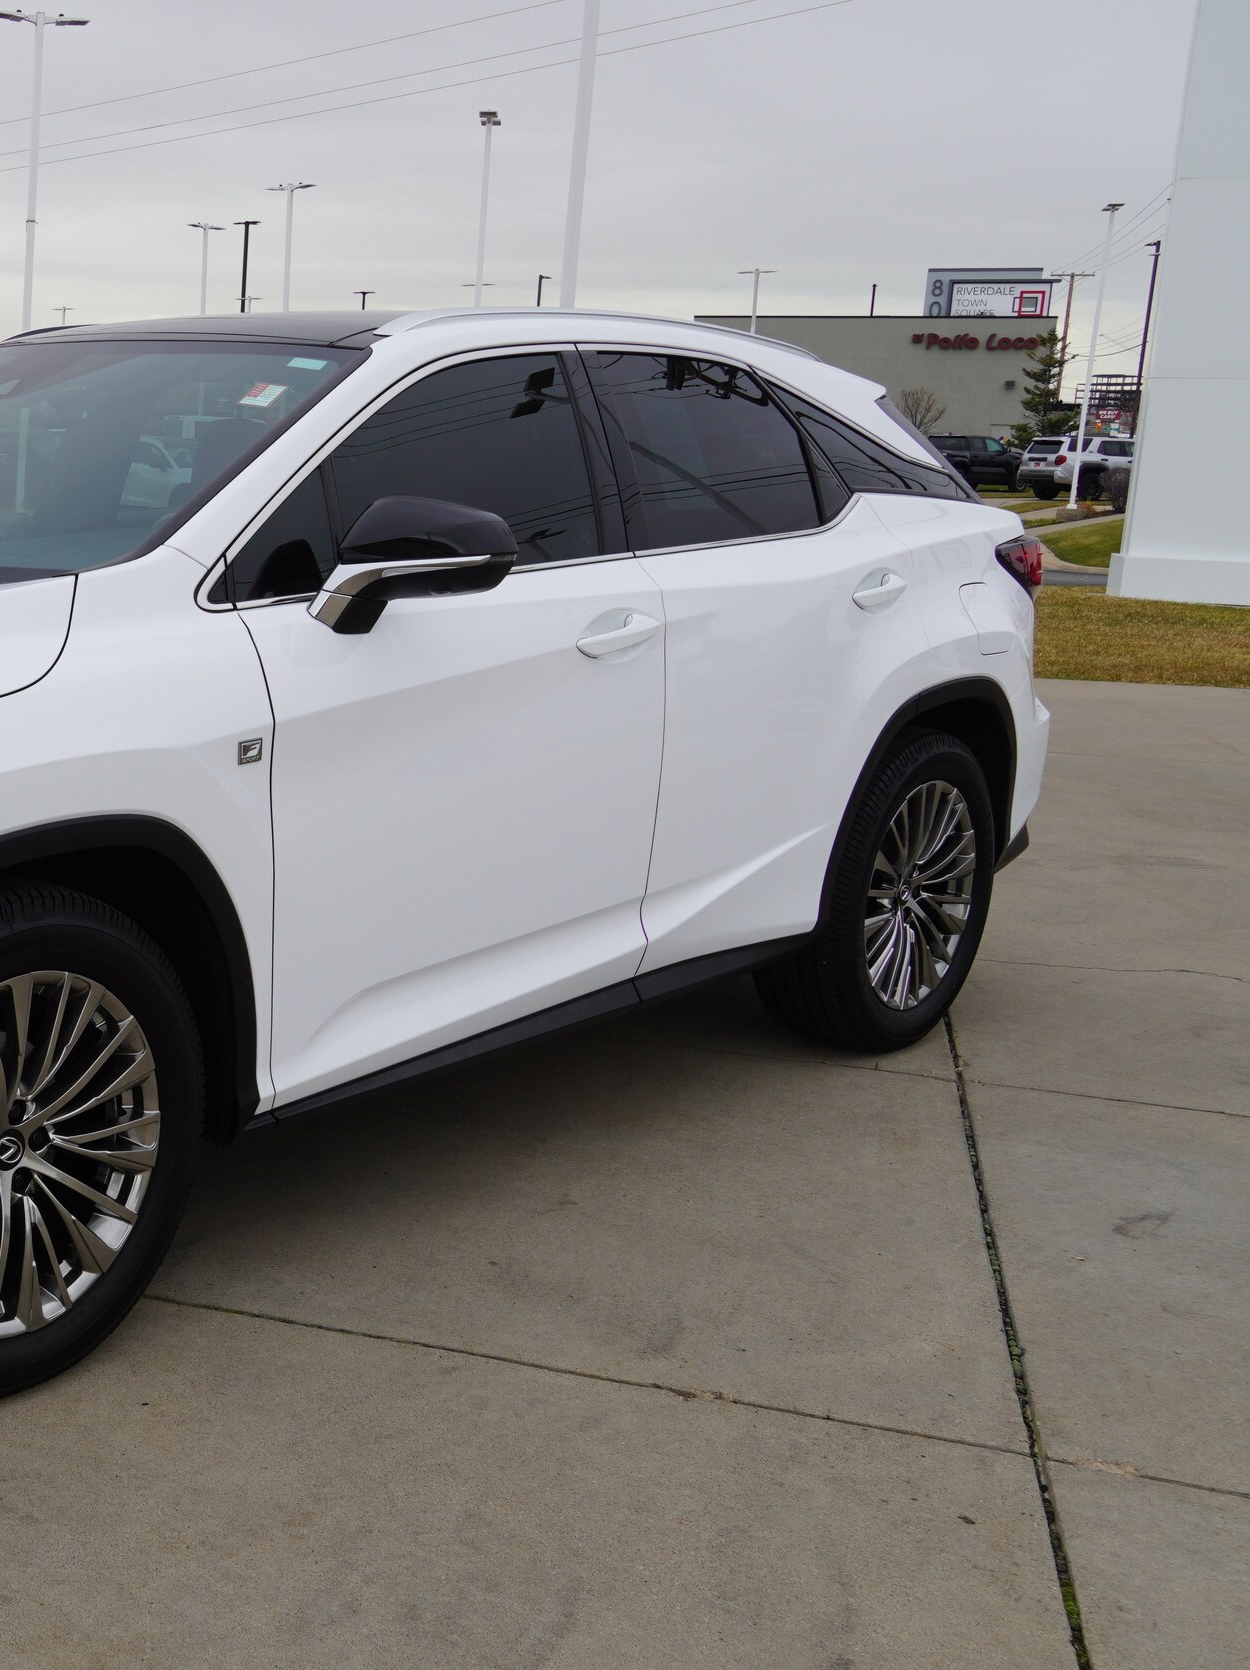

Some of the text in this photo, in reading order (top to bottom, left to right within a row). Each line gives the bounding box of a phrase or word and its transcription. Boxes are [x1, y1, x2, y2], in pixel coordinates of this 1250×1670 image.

[956, 286, 1016, 296] RIVERDALE
[956, 299, 988, 308] TOWN
[926, 332, 980, 350] Pollo
[986, 333, 1040, 351] Loco
